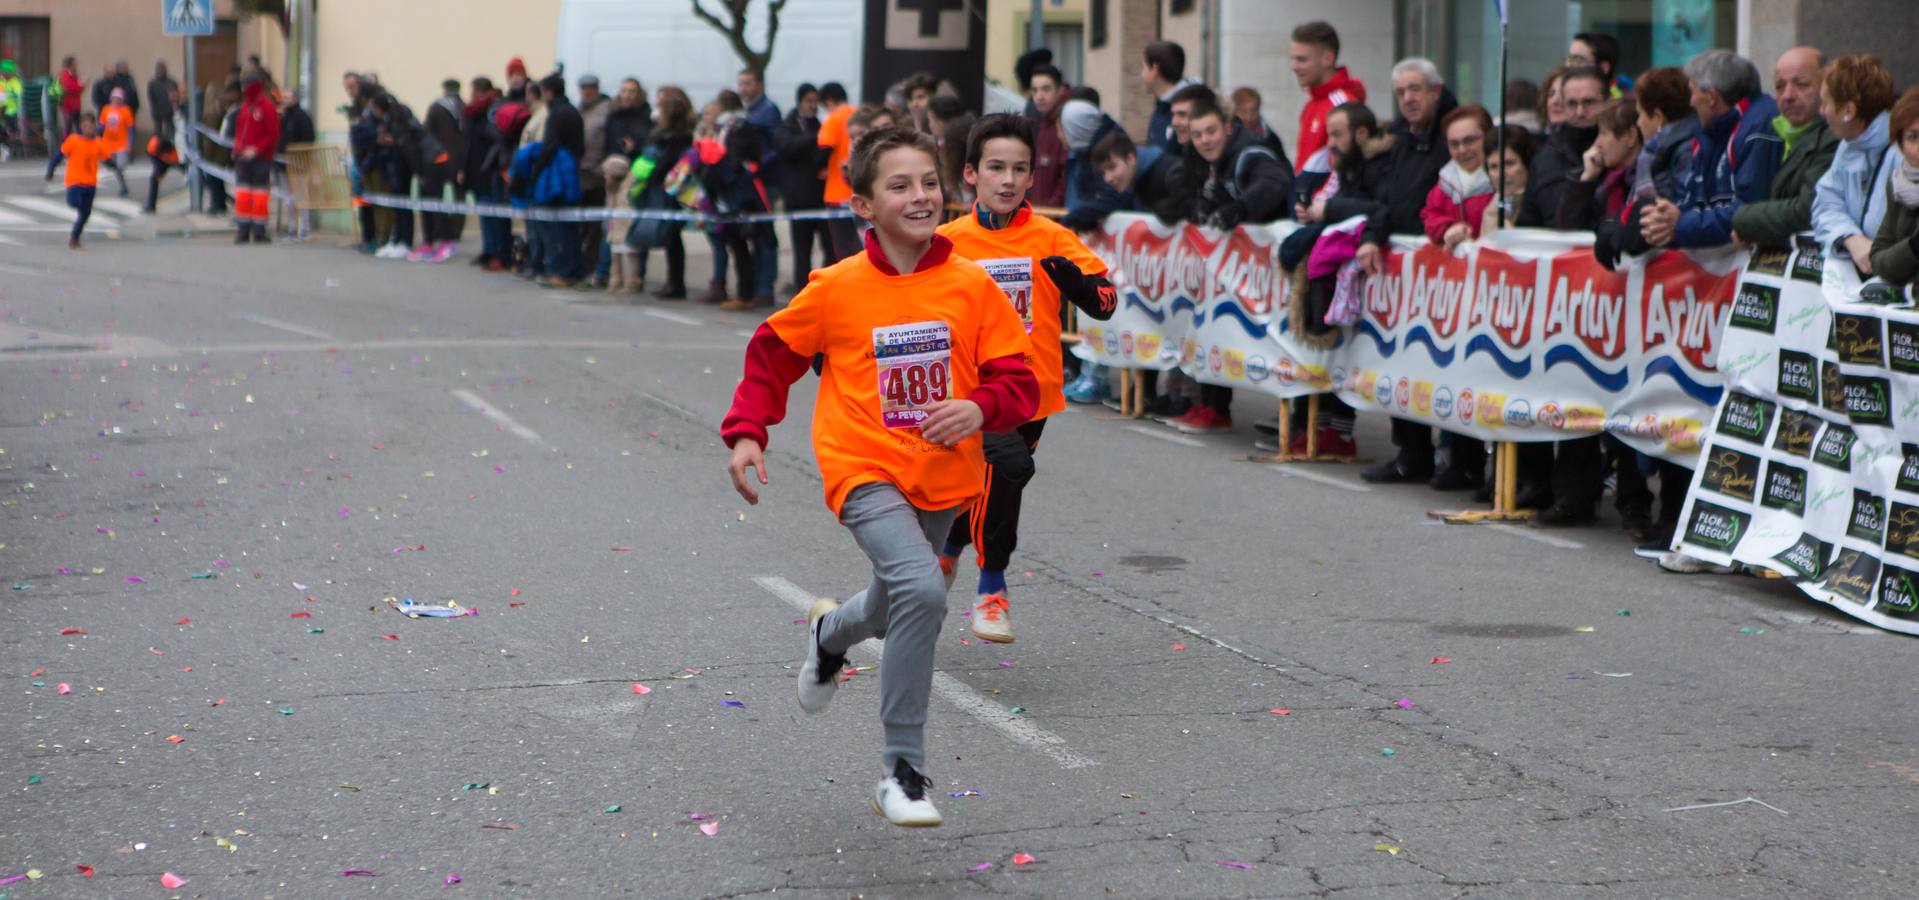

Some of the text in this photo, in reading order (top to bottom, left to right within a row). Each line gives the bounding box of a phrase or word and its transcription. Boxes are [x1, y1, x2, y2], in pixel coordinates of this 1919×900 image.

[1365, 270, 1400, 327] rluy
[1410, 263, 1462, 335] Arluy
[1471, 270, 1532, 345] Arluy
[1547, 276, 1622, 356] Arluy
[888, 326, 948, 338] AYUNTAMIENTO
[889, 334, 937, 345] DE LARDERO
[1645, 283, 1730, 368] Arluy
[886, 362, 948, 406] 489
[1694, 522, 1731, 541] IREGUA
[1698, 512, 1722, 527] FLOR
